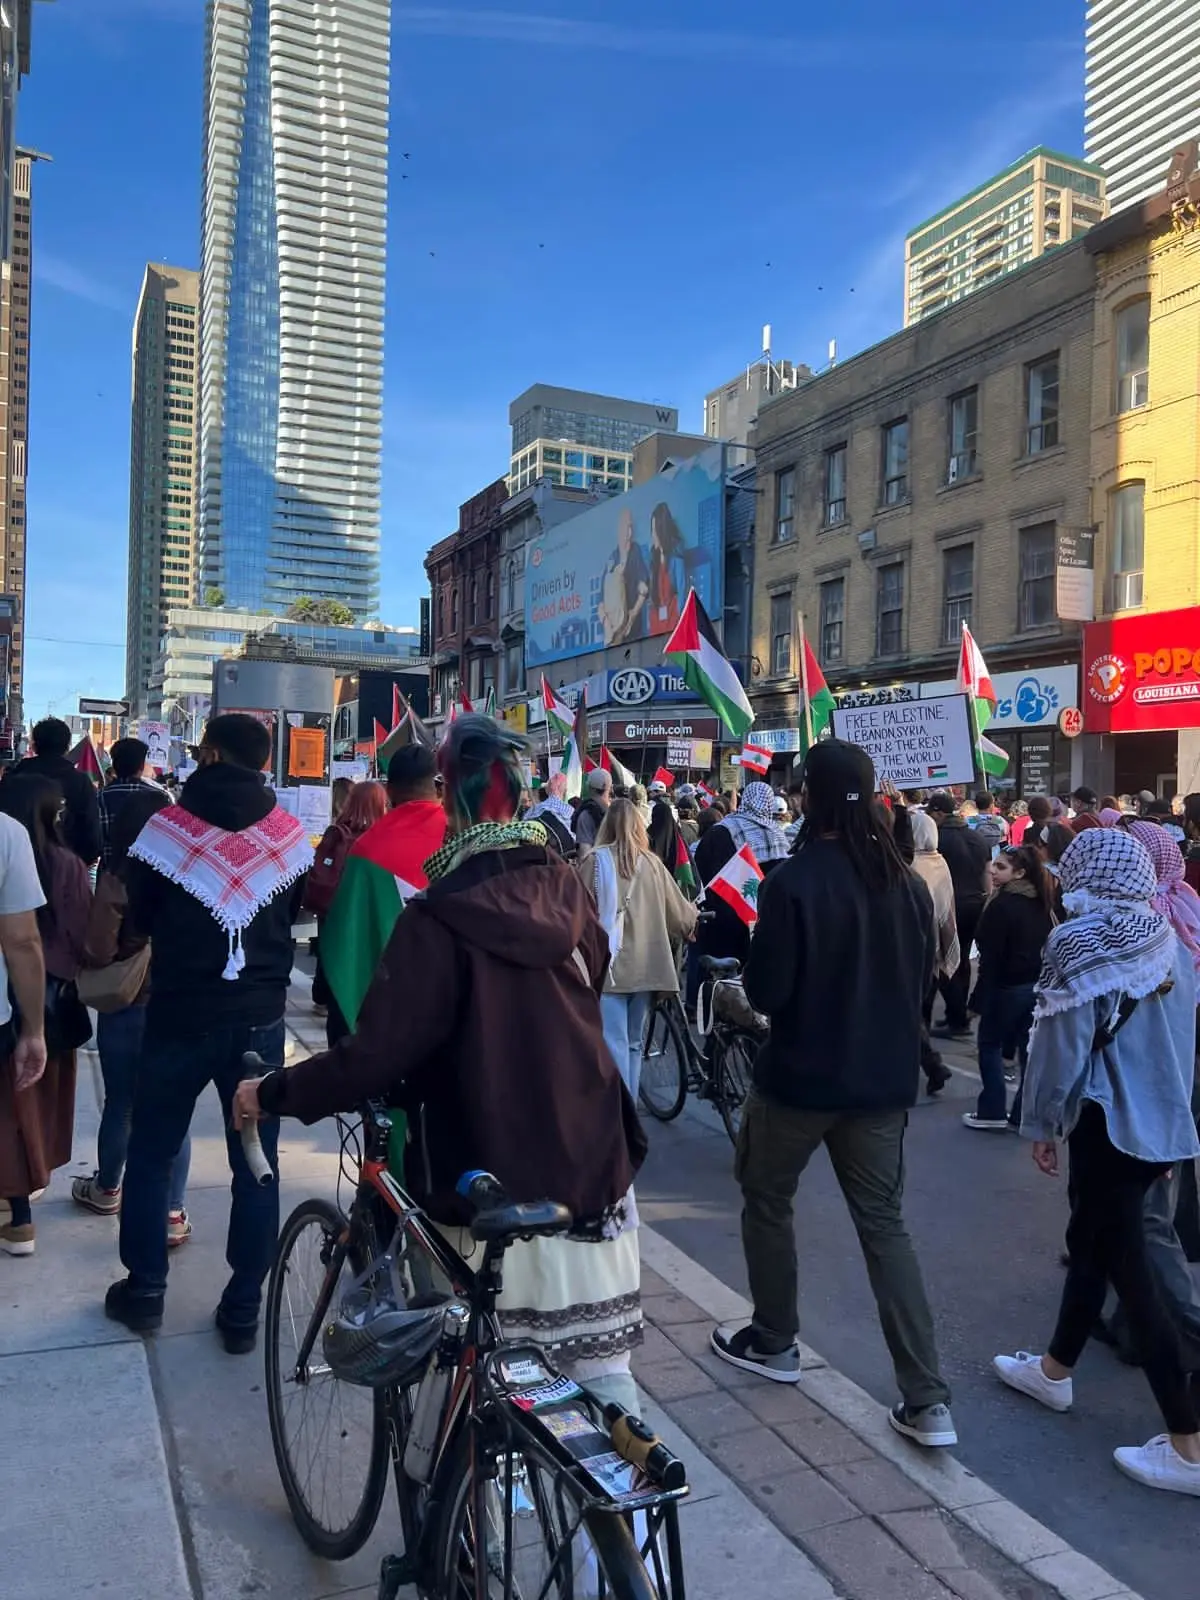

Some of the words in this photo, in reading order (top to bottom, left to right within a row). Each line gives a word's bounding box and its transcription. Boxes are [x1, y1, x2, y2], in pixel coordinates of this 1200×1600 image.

[656, 410, 671, 422] W
[532, 577, 561, 600] Driven
[563, 569, 576, 591] by
[532, 601, 557, 624] Good
[559, 593, 582, 612] Acts
[615, 672, 649, 699] CAA
[659, 674, 691, 691] The
[1138, 685, 1198, 699] LOUISIANA
[846, 711, 880, 729] FREE
[883, 704, 949, 724] PALESTINE,
[1065, 710, 1081, 725] 24
[862, 743, 882, 754] MEN
[886, 742, 892, 752] &
[668, 758, 689, 766] GAZA
[880, 753, 903, 766] THE
[906, 751, 942, 764] WORLD
[880, 767, 922, 780] ZIONISM
